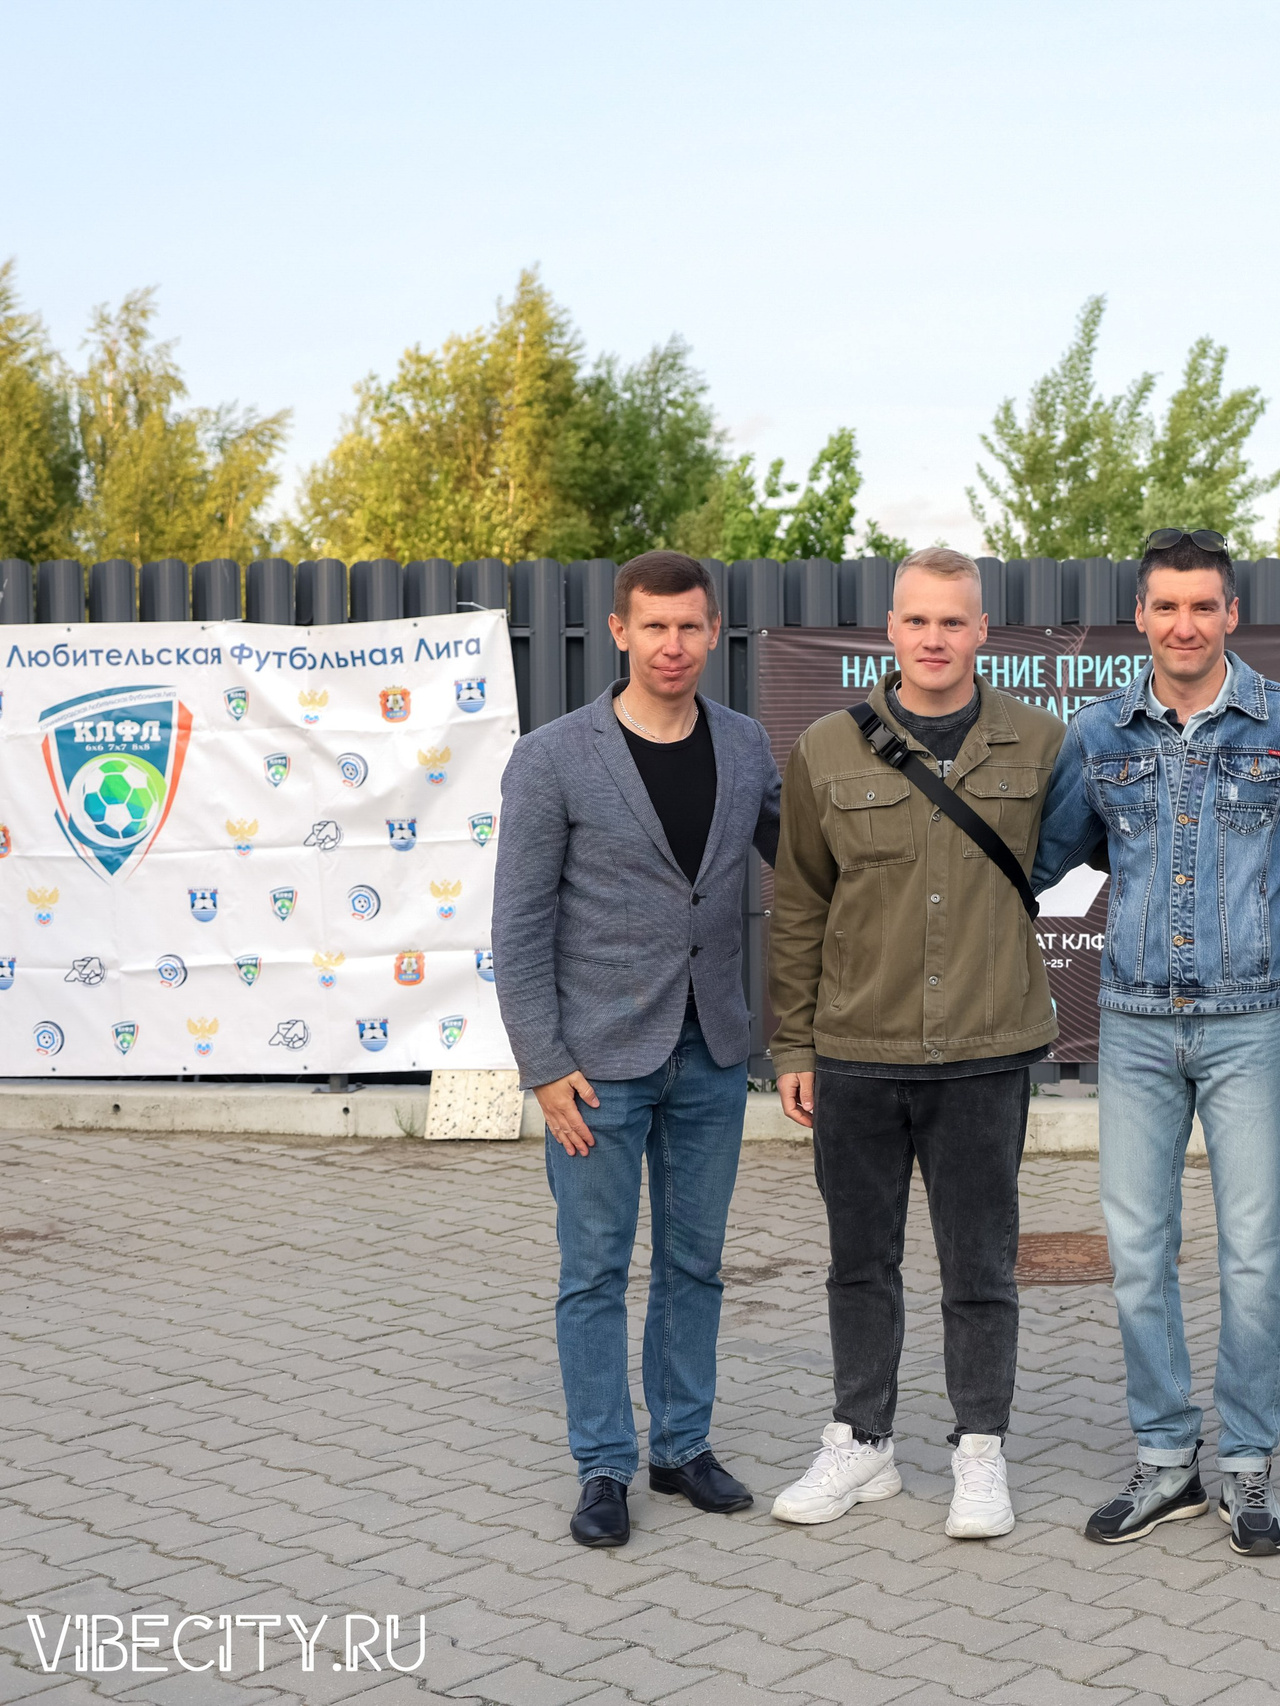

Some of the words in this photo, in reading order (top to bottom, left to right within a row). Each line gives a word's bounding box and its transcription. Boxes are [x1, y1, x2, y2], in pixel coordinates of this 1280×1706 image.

[6, 643, 223, 668] Любительская
[414, 637, 481, 662] Лига
[1056, 655, 1153, 688] ПРИЗЕ
[73, 720, 161, 742] КЛФЛ
[1062, 933, 1105, 950] КЛФ
